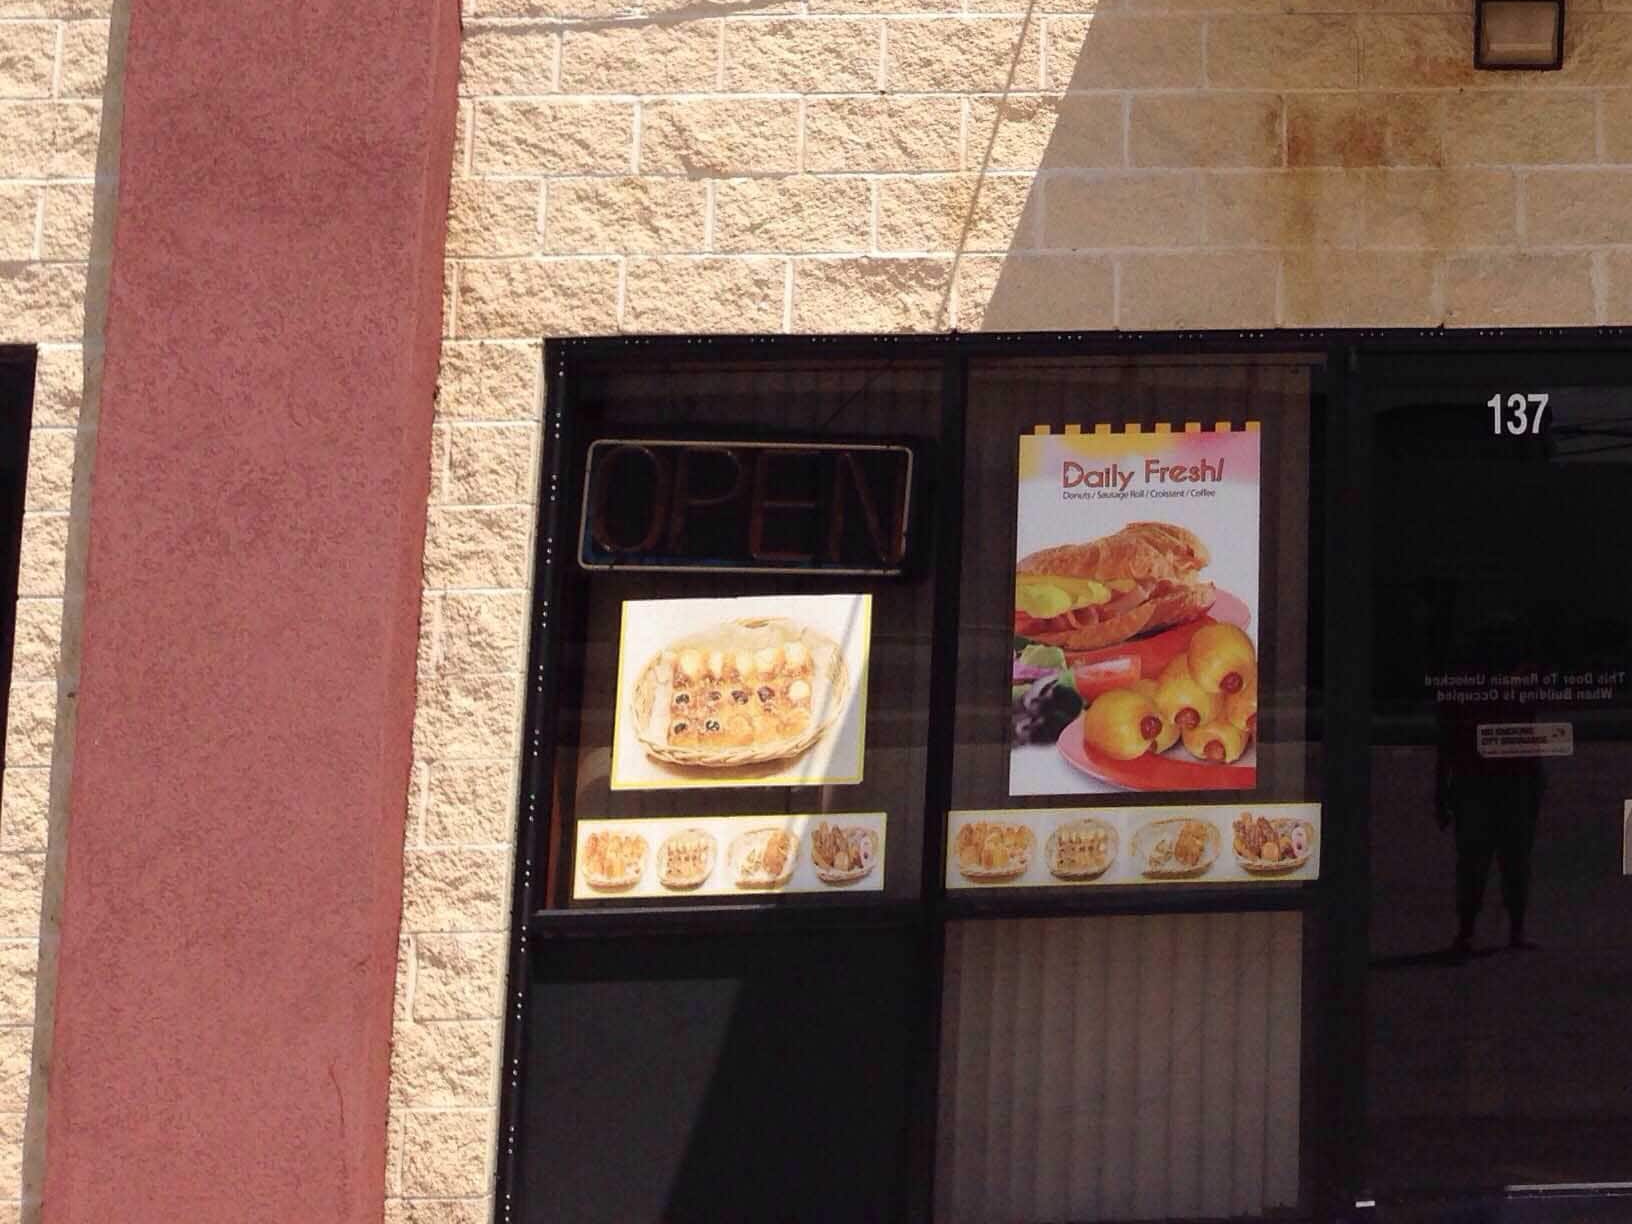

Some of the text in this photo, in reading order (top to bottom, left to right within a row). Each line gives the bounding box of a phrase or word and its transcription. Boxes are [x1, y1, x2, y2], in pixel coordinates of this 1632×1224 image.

[1486, 393, 1549, 436] 137
[1062, 457, 1225, 491] Daily Fresh!
[590, 442, 908, 563] OPEN
[1062, 491, 1091, 500] Donuts
[1097, 491, 1129, 502] Sausage
[1190, 489, 1216, 498] Coffee
